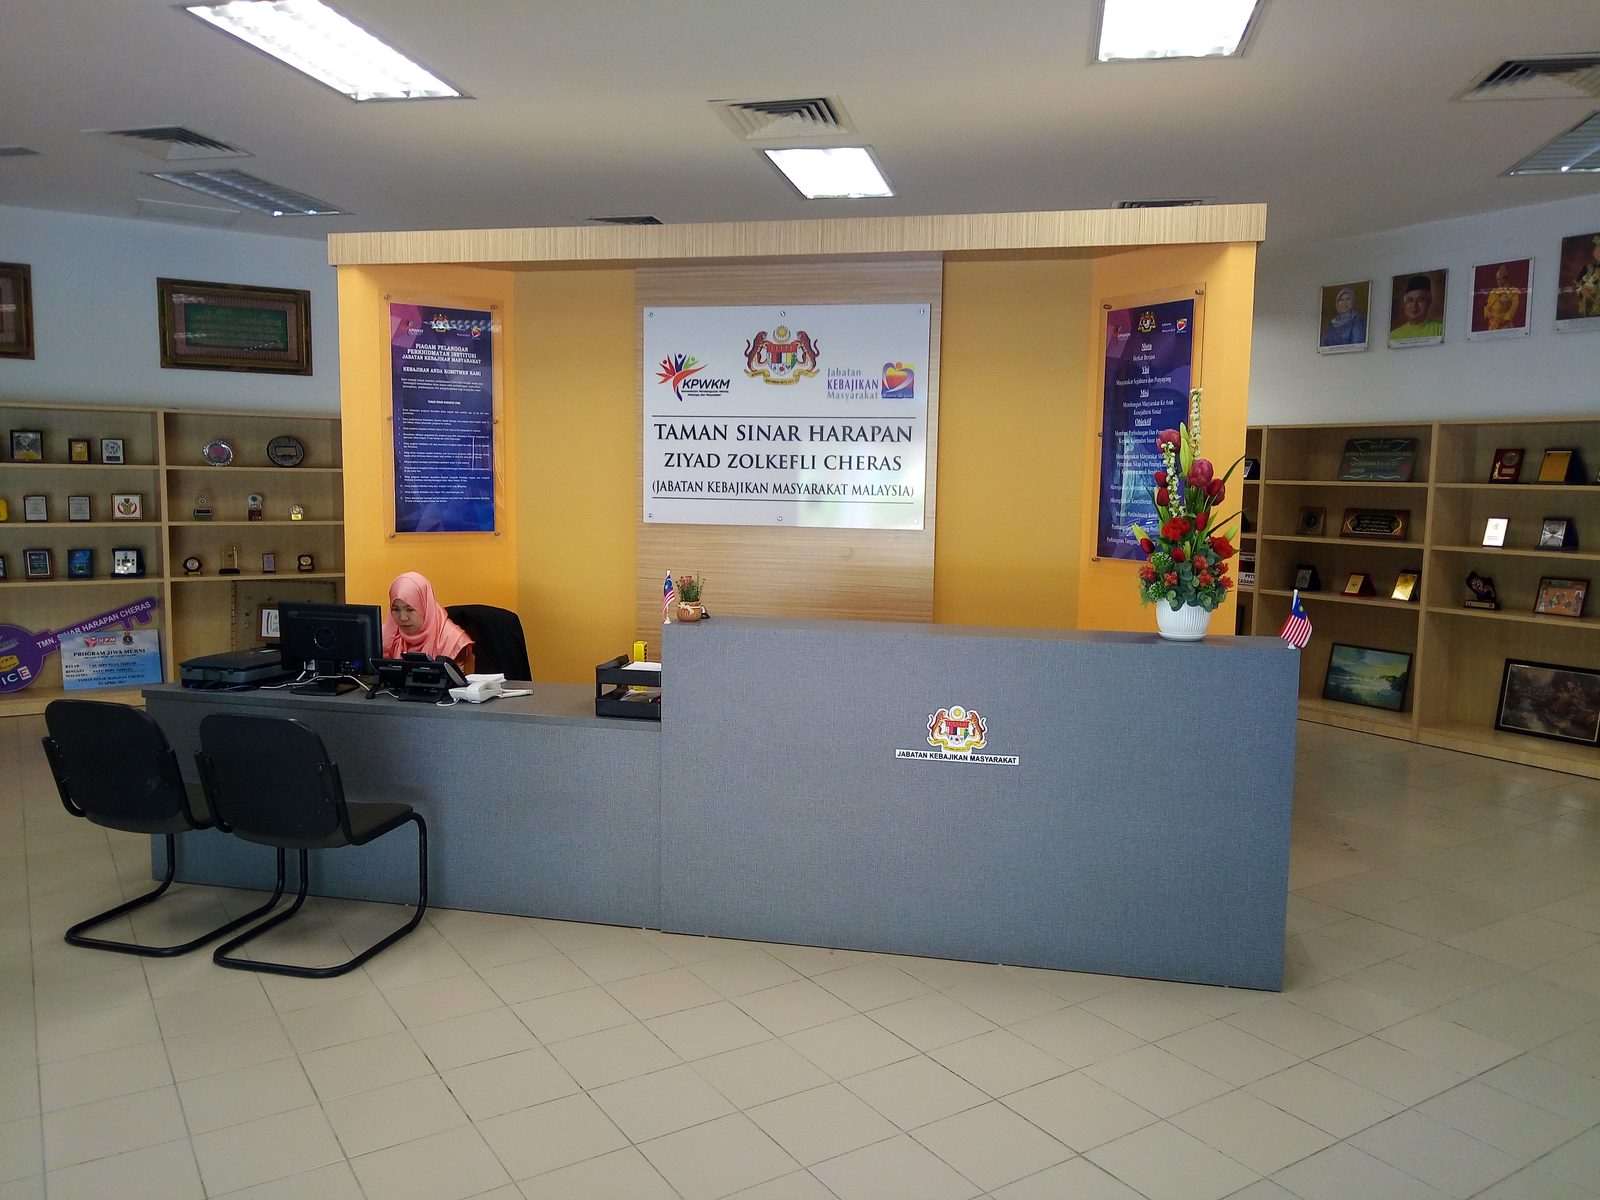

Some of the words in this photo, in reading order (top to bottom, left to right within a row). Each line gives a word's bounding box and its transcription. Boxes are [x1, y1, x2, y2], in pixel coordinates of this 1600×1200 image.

[407, 348, 450, 357] PERKHIDMATAN
[451, 351, 477, 359] INSTITUSI
[437, 344, 468, 352] PELANGGAN
[828, 368, 861, 377] Jabatan
[682, 379, 731, 389] KPWKM
[827, 379, 879, 391] KEBAJIKAN
[827, 391, 878, 400] Masyarakat
[653, 423, 728, 442] TAMAN
[736, 424, 803, 442] SINAR
[808, 425, 913, 443] HARAPAN
[664, 452, 721, 469] ZIYAD
[727, 453, 816, 470] ZOLKEFLI
[823, 455, 902, 471] CHERAS
[652, 480, 703, 494] (JABATAN
[707, 481, 769, 496] KEBAJIKAN
[772, 482, 848, 496] MASYARAKAT
[851, 484, 914, 498] MALAYSIA)
[36, 637, 57, 649] TMN.
[81, 613, 120, 632] HARAPAN
[119, 601, 151, 618] CHERAS
[896, 750, 928, 759] JABATAN
[929, 752, 968, 762] KEBAJIKAN
[969, 755, 1017, 764] MASYARAKAT
